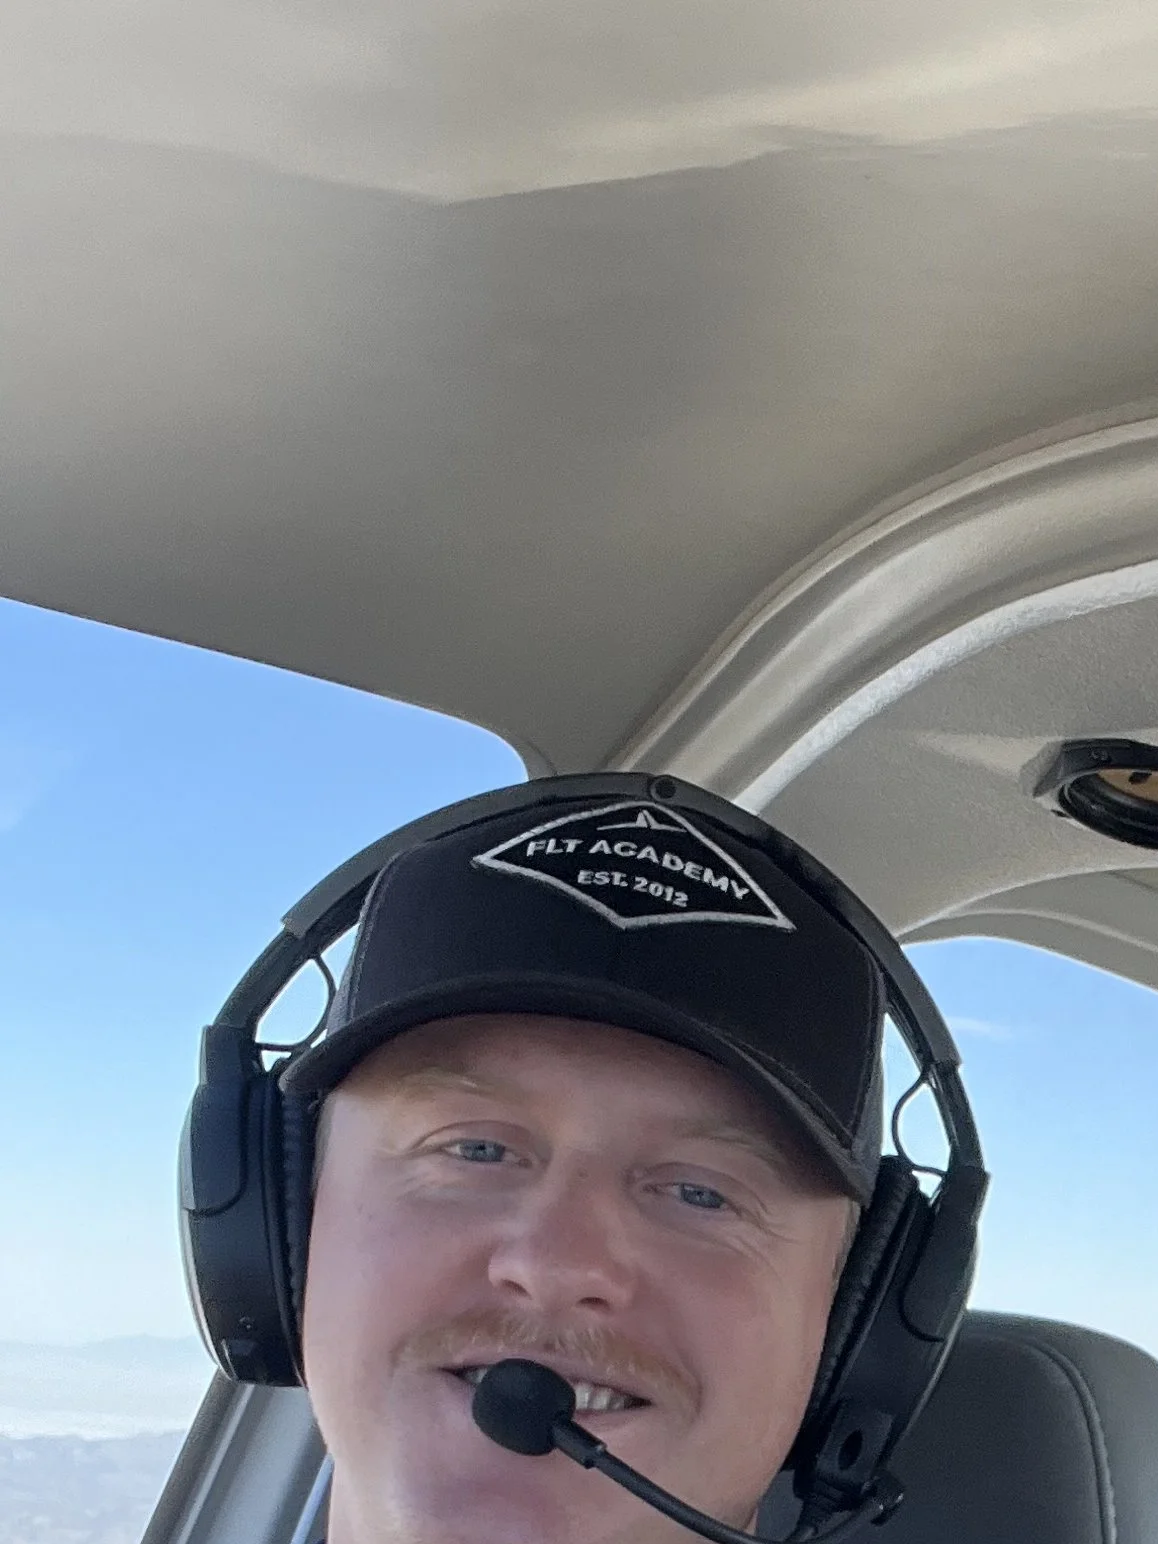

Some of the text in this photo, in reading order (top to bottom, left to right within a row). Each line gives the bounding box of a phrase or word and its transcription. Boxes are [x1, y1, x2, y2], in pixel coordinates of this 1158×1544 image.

[526, 838, 750, 900] FLT ACADEMY
[577, 870, 689, 907] EST. 2012
